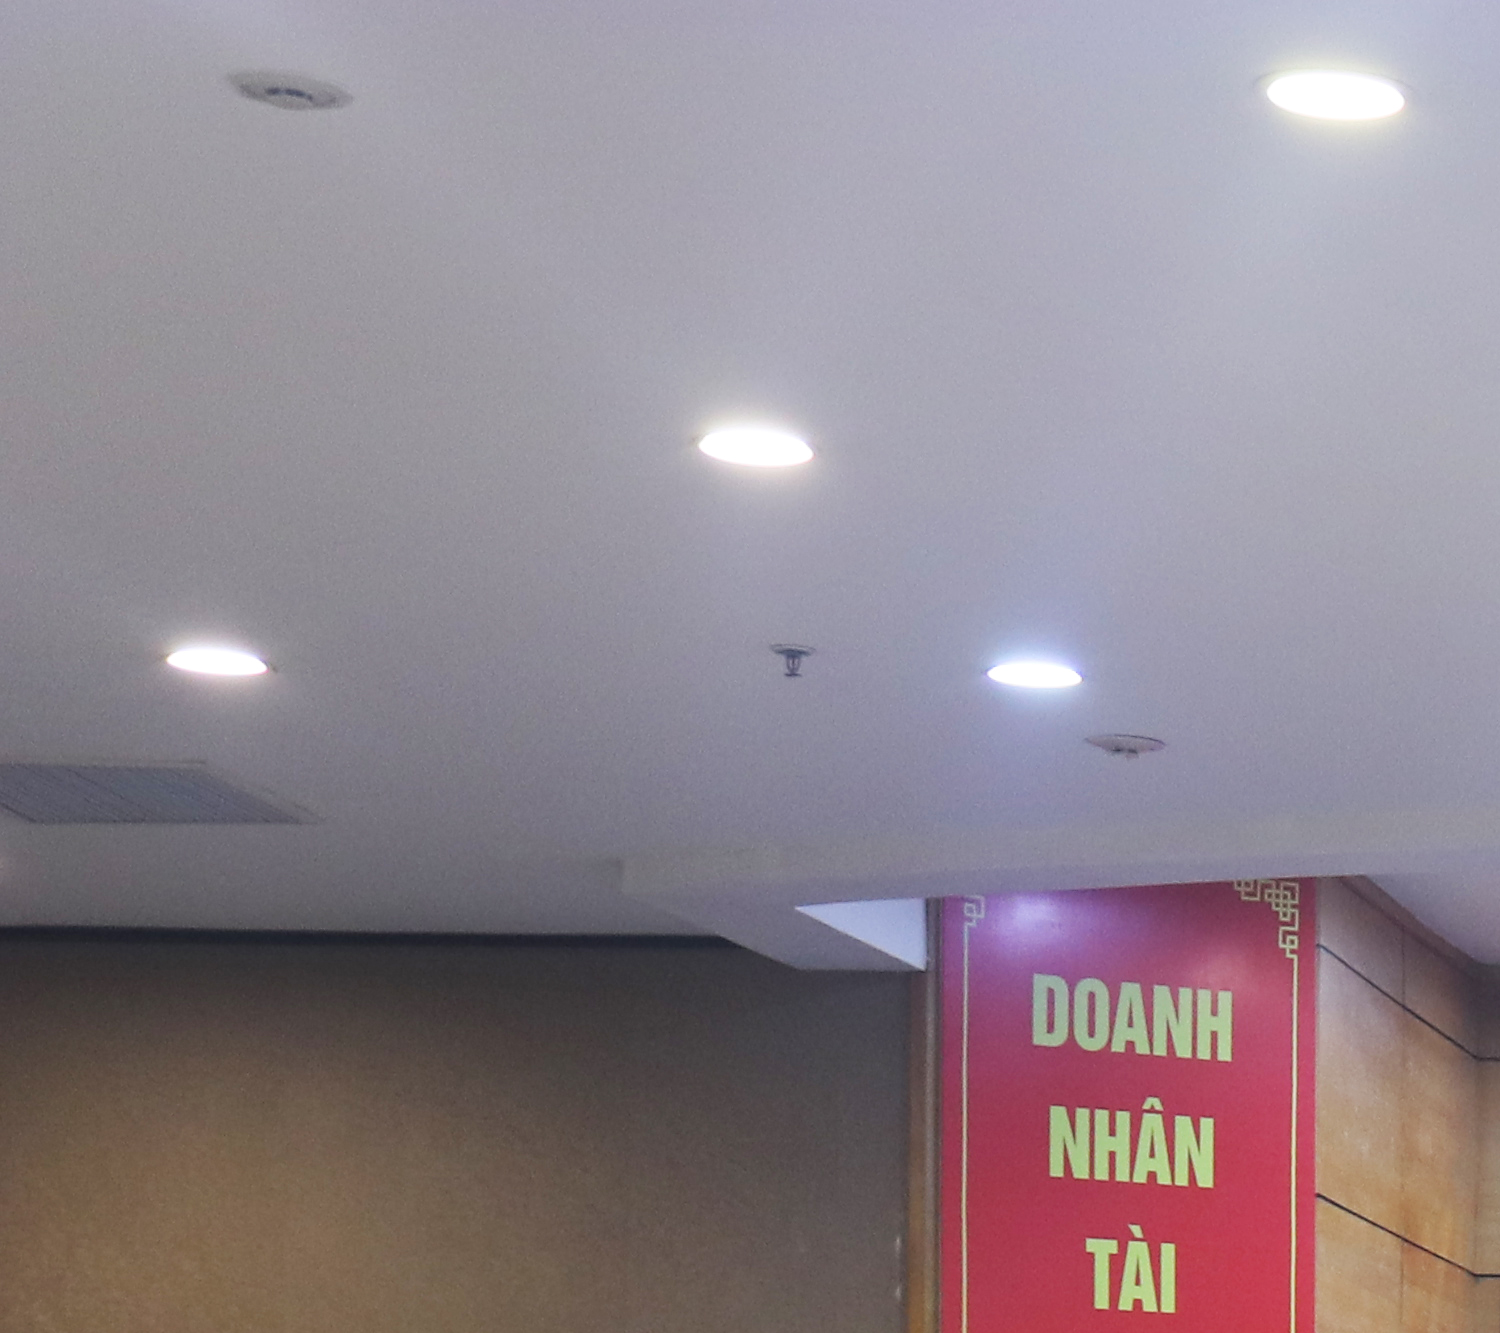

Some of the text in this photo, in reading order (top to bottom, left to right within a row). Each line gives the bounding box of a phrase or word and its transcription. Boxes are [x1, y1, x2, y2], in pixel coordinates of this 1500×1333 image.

[1031, 972, 1234, 1063] DOANH
[1049, 1096, 1215, 1189] NHÂN
[1085, 1225, 1177, 1314] TÀI
